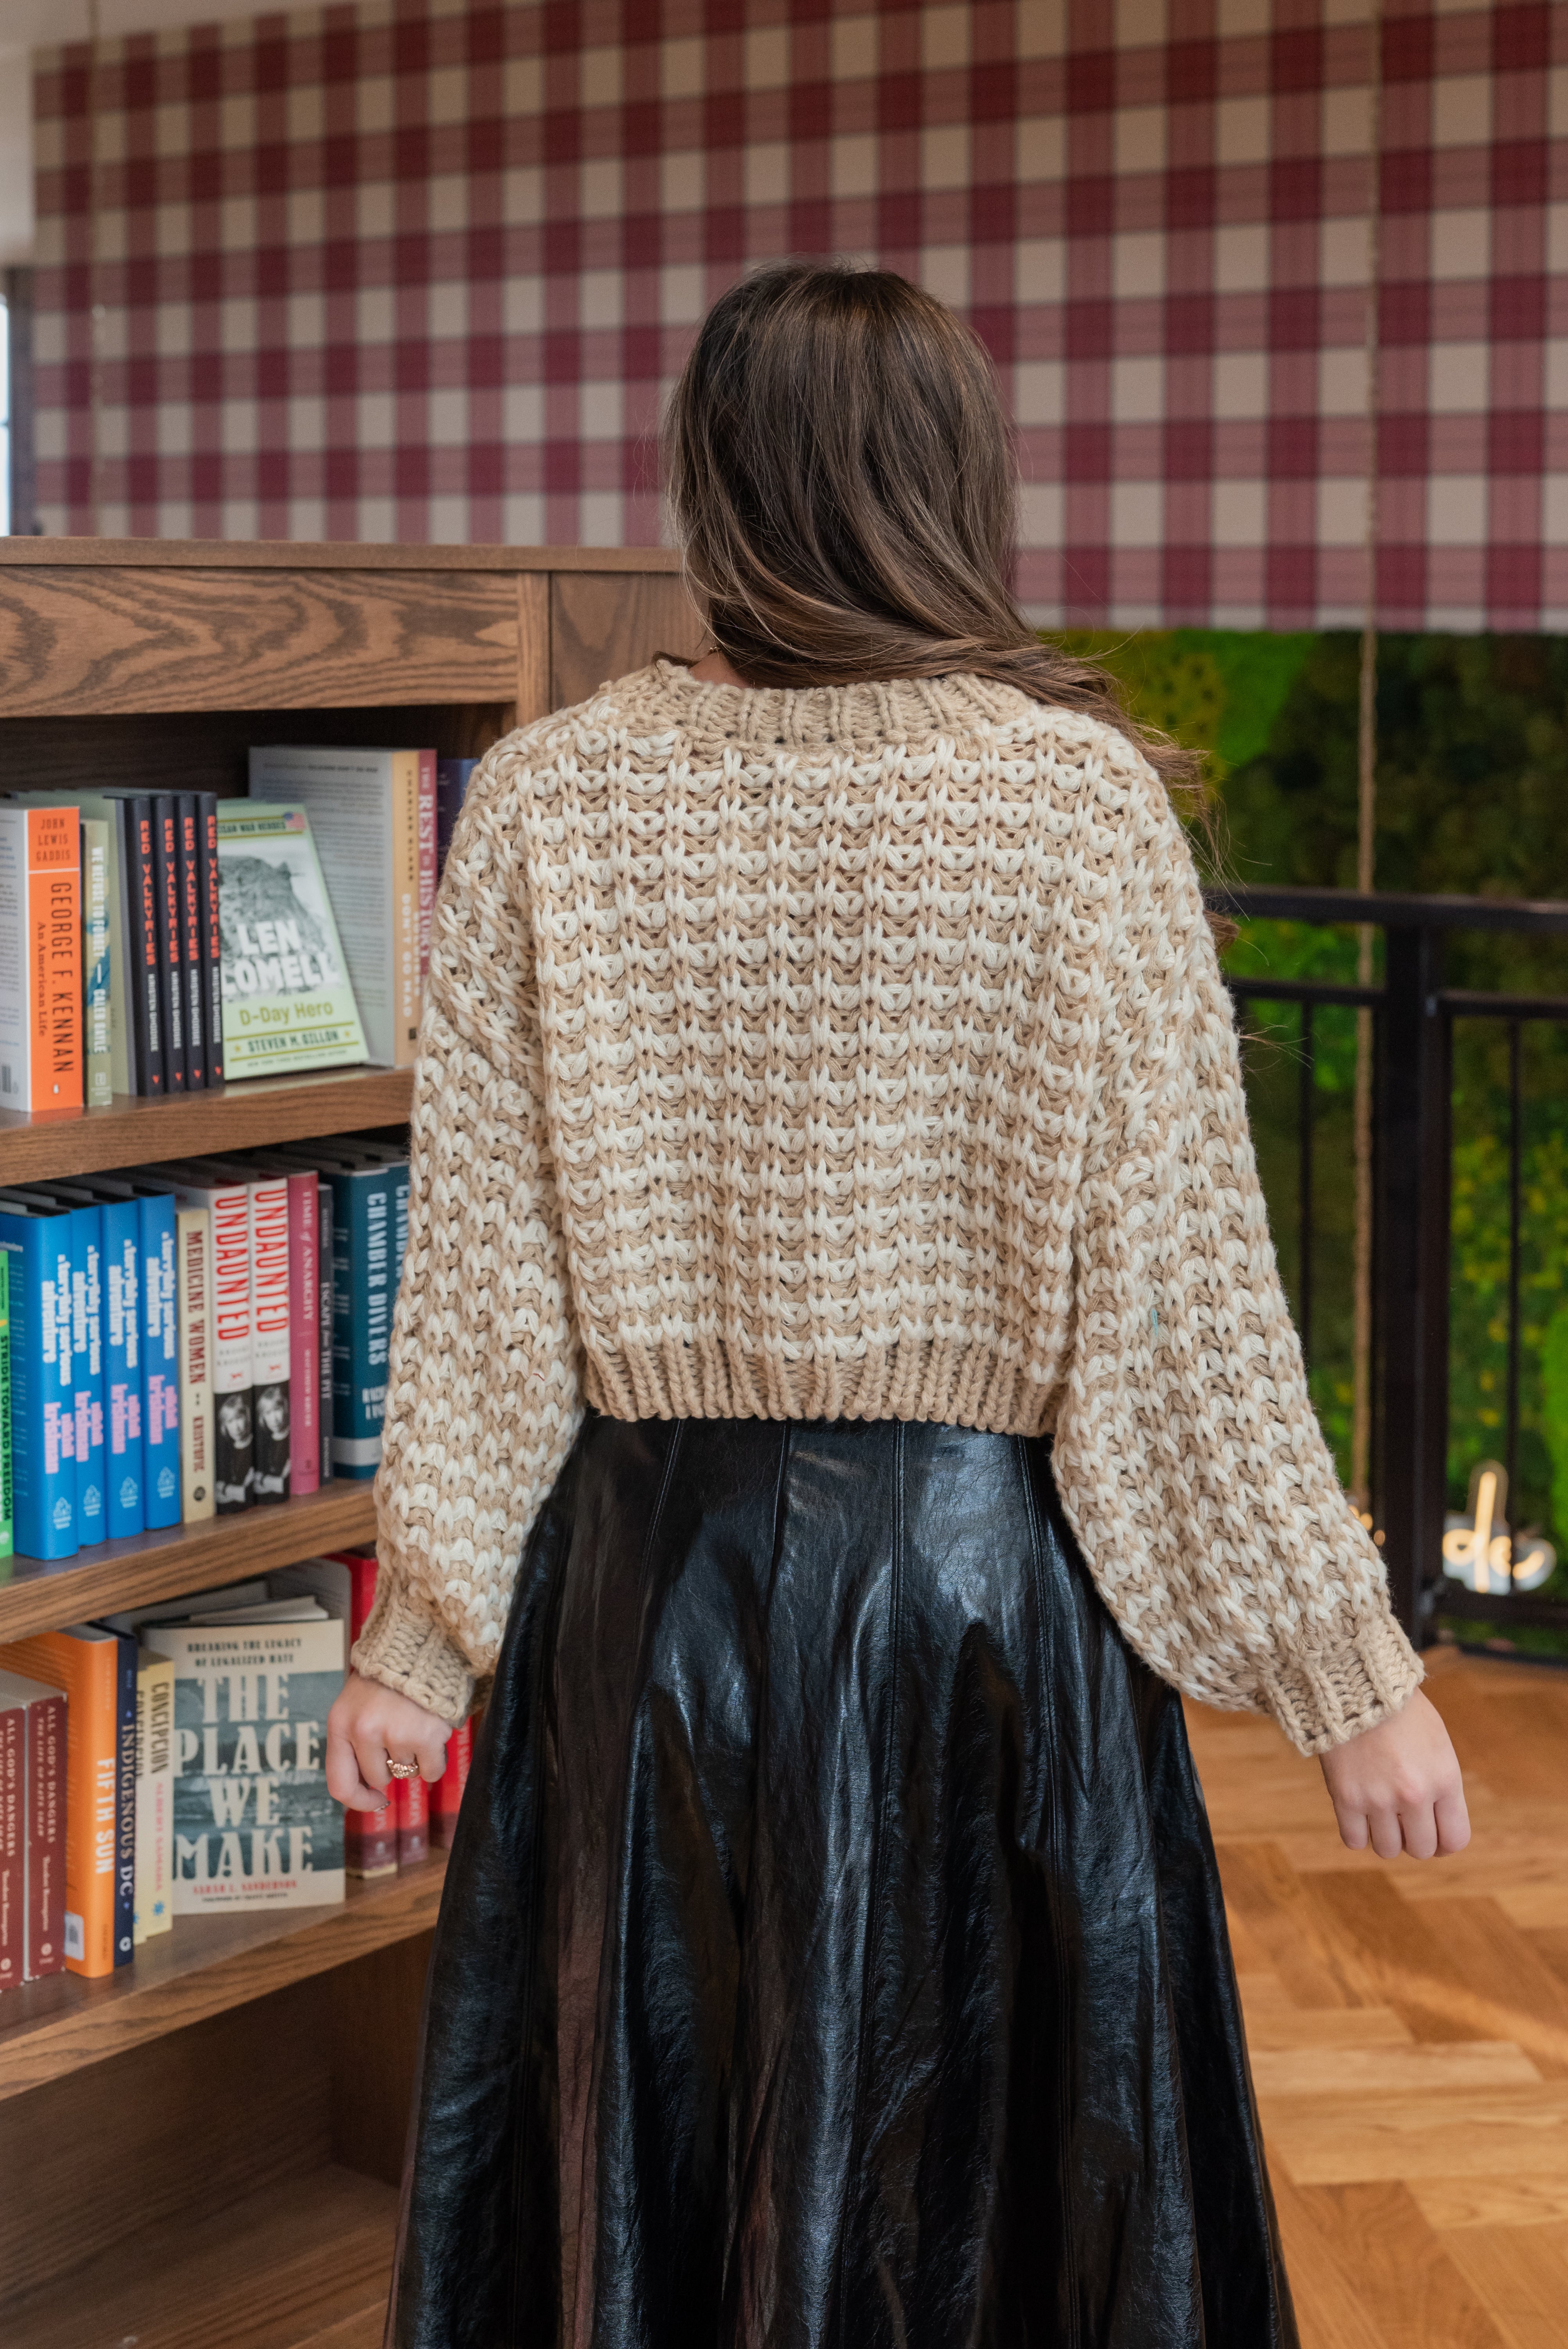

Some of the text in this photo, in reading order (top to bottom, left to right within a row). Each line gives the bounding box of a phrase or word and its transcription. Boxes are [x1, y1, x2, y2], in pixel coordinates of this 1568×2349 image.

[36, 850, 71, 862] GADDIS
[38, 833, 68, 847] LEWIS
[41, 818, 65, 830] JOHN
[419, 794, 434, 854] REST
[92, 847, 105, 957] WE REFUSE TO FORGET
[140, 820, 155, 966] RED VALKYRIES
[164, 819, 179, 963] RED VALKYRIES
[184, 817, 199, 961] RED VALKYRIES
[207, 815, 220, 959] RED VALKYRIES
[37, 922, 47, 1036] An American Life
[51, 882, 74, 1072] GEORGE F. KENNAN
[220, 952, 342, 995] LOMELL
[236, 919, 303, 956] LEN
[402, 893, 412, 1017] DON'T GO MAD
[239, 1002, 333, 1026] D-Day Hero
[247, 1035, 287, 1053] STEVEN
[303, 1191, 312, 1228] TIME
[367, 1192, 387, 1288] CHAMBER
[186, 1231, 205, 1384] MEDICINE WOMEN
[215, 1194, 250, 1340] UNDAUNTED
[255, 1188, 288, 1332] UNDAUNTED
[303, 1246, 314, 1320] ANARCHY
[368, 1292, 388, 1365] DIVERS
[1, 1335, 11, 1520] STRIDE TOWARD FREEDOM
[150, 1681, 169, 1775] CONCEPCION
[196, 1673, 289, 1724] THE
[7, 1718, 15, 1857] ALL GOD'S DANGERS
[47, 1706, 56, 1843] ALL GOD'S DANGERS
[173, 1721, 320, 1778] PLACE
[95, 1757, 115, 1875] FIFTH SUN
[119, 1723, 136, 1897] INDIGENOUS DC
[208, 1775, 280, 1828] WE
[175, 1826, 313, 1881] MAKE
